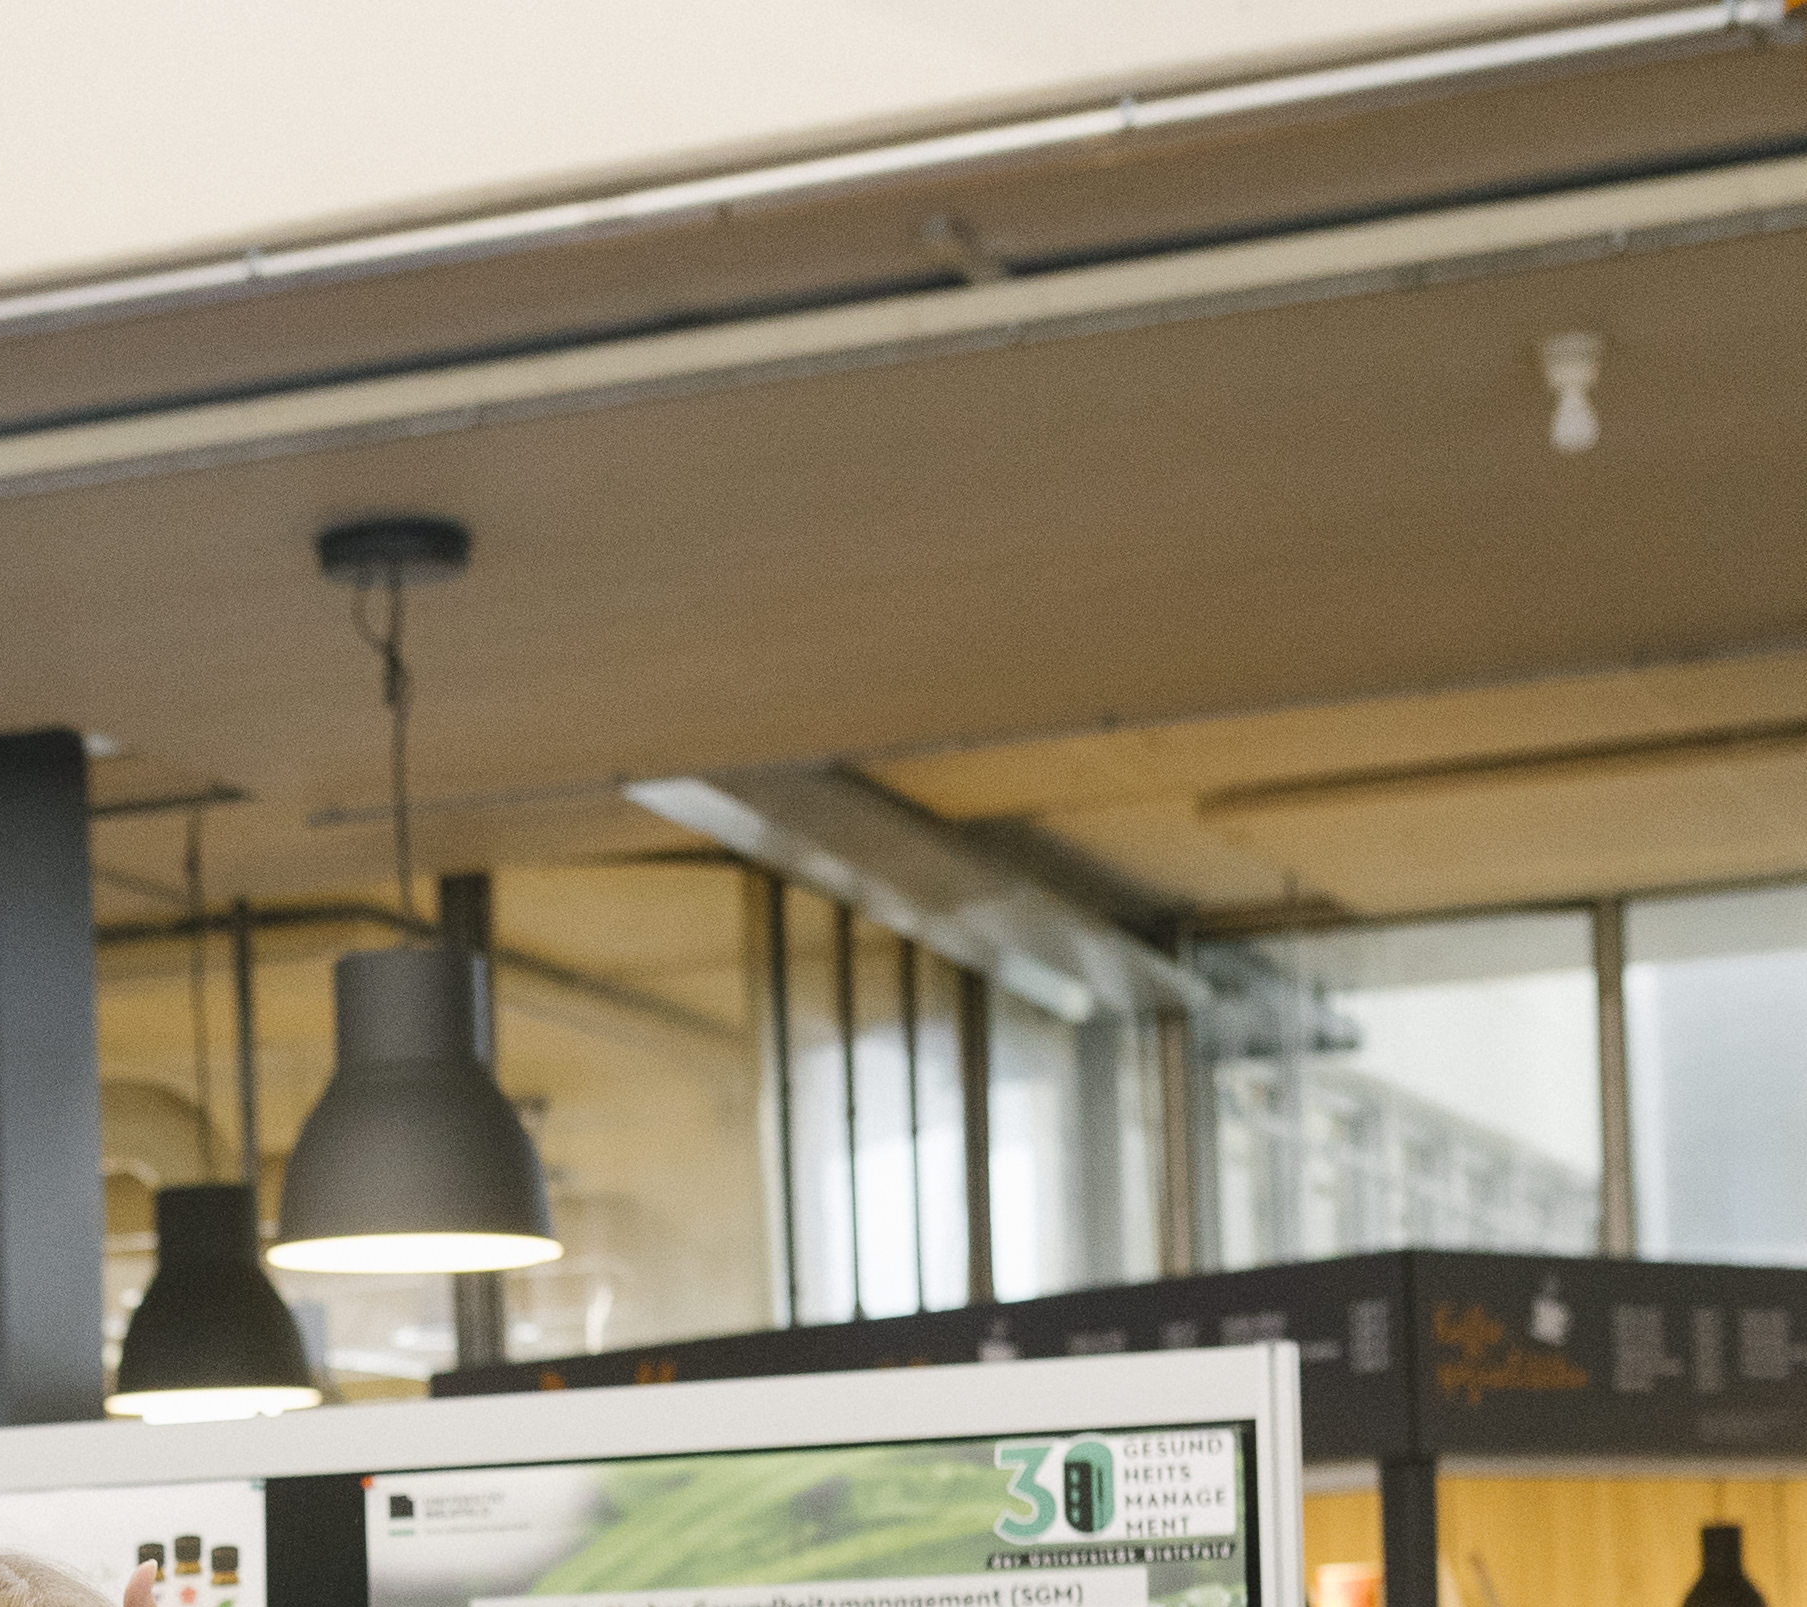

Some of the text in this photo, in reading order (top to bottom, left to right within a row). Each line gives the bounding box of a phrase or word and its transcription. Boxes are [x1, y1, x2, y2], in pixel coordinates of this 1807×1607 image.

[1123, 1438, 1223, 1459] GESUND
[1124, 1465, 1191, 1484] HEITS
[1125, 1489, 1227, 1510] MANAGE
[1125, 1516, 1190, 1539] MENT
